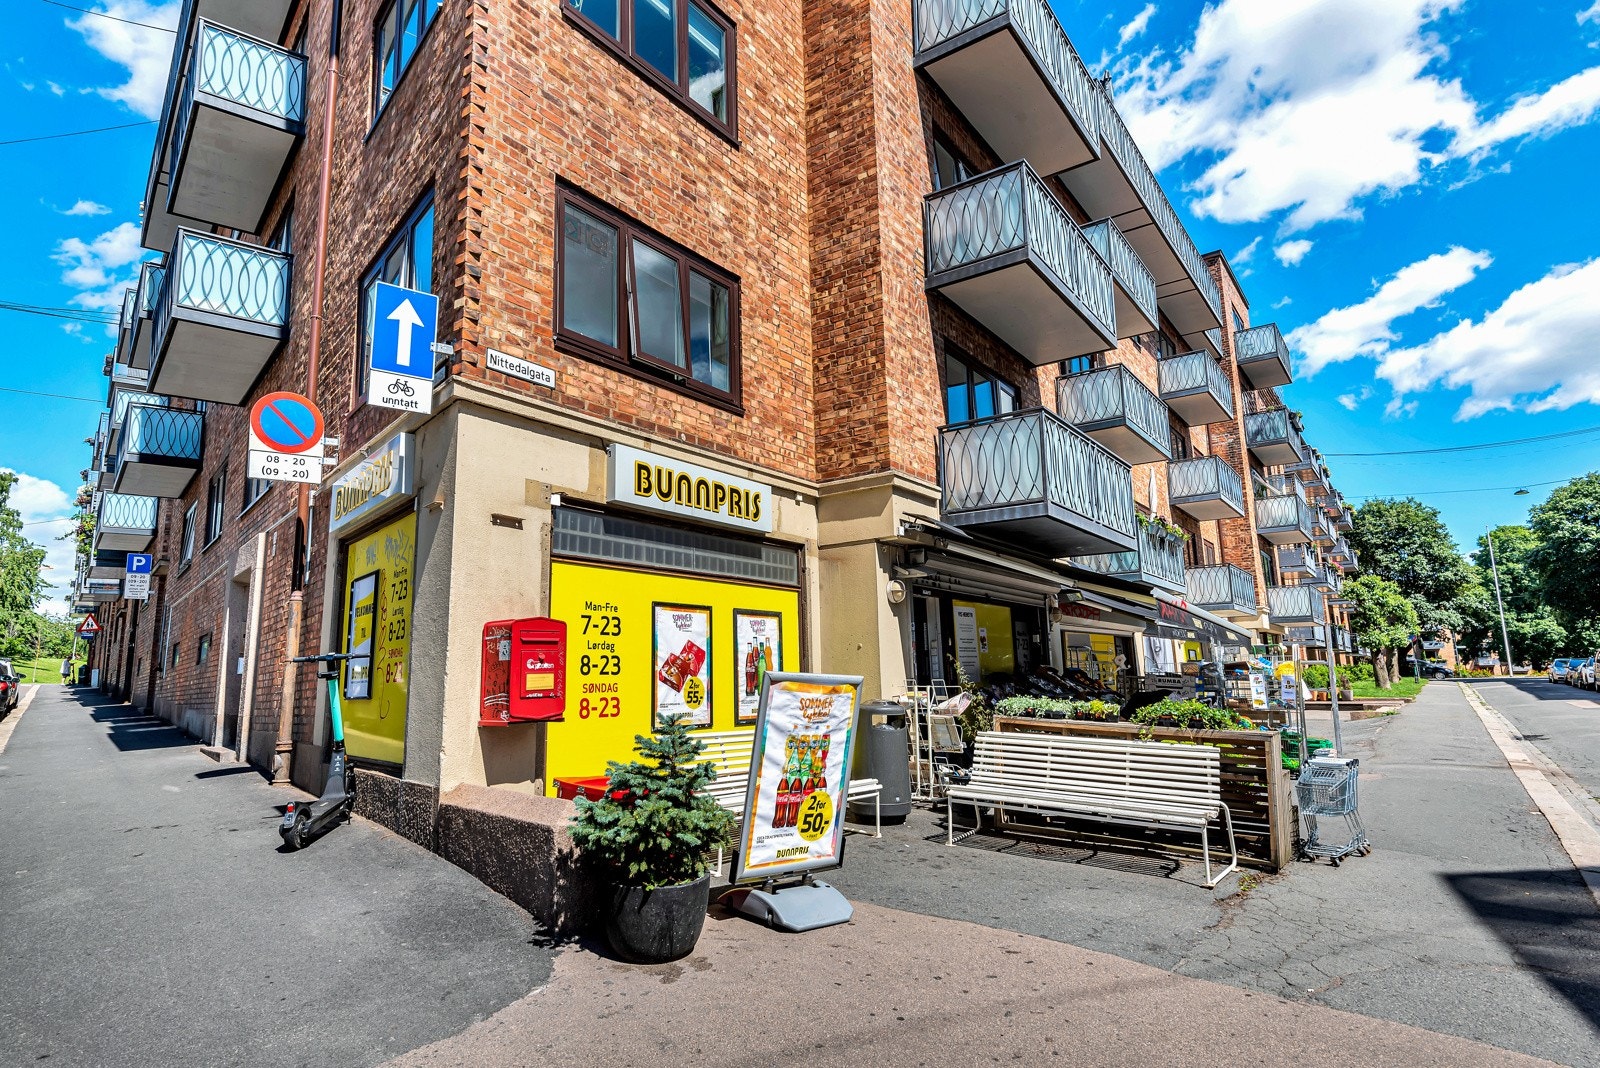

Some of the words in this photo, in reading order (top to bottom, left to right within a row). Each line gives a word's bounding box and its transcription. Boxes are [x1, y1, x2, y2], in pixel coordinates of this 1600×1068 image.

[489, 353, 551, 383] Nittedalgata
[382, 396, 418, 409] unntatt
[266, 455, 280, 464] 08
[292, 457, 306, 466] 20
[261, 465, 279, 476] (09
[292, 469, 309, 479] 20)
[334, 449, 394, 521] BUNNPRIS
[634, 460, 761, 522] BUNNPRIS
[132, 556, 146, 571] P
[391, 578, 408, 603] 7-23
[584, 601, 618, 613] Man-Fre
[388, 618, 406, 642] 8-23
[580, 614, 621, 637] 7-23
[587, 640, 615, 653] Lørdag
[580, 654, 621, 676] 8-23
[582, 682, 618, 694] SØNDAG
[688, 679, 694, 689] 2
[579, 696, 620, 719] 8-23
[807, 795, 818, 811] 2
[816, 800, 827, 812] for
[800, 812, 830, 835] 50,-
[776, 846, 810, 859] BUNNPRIS
